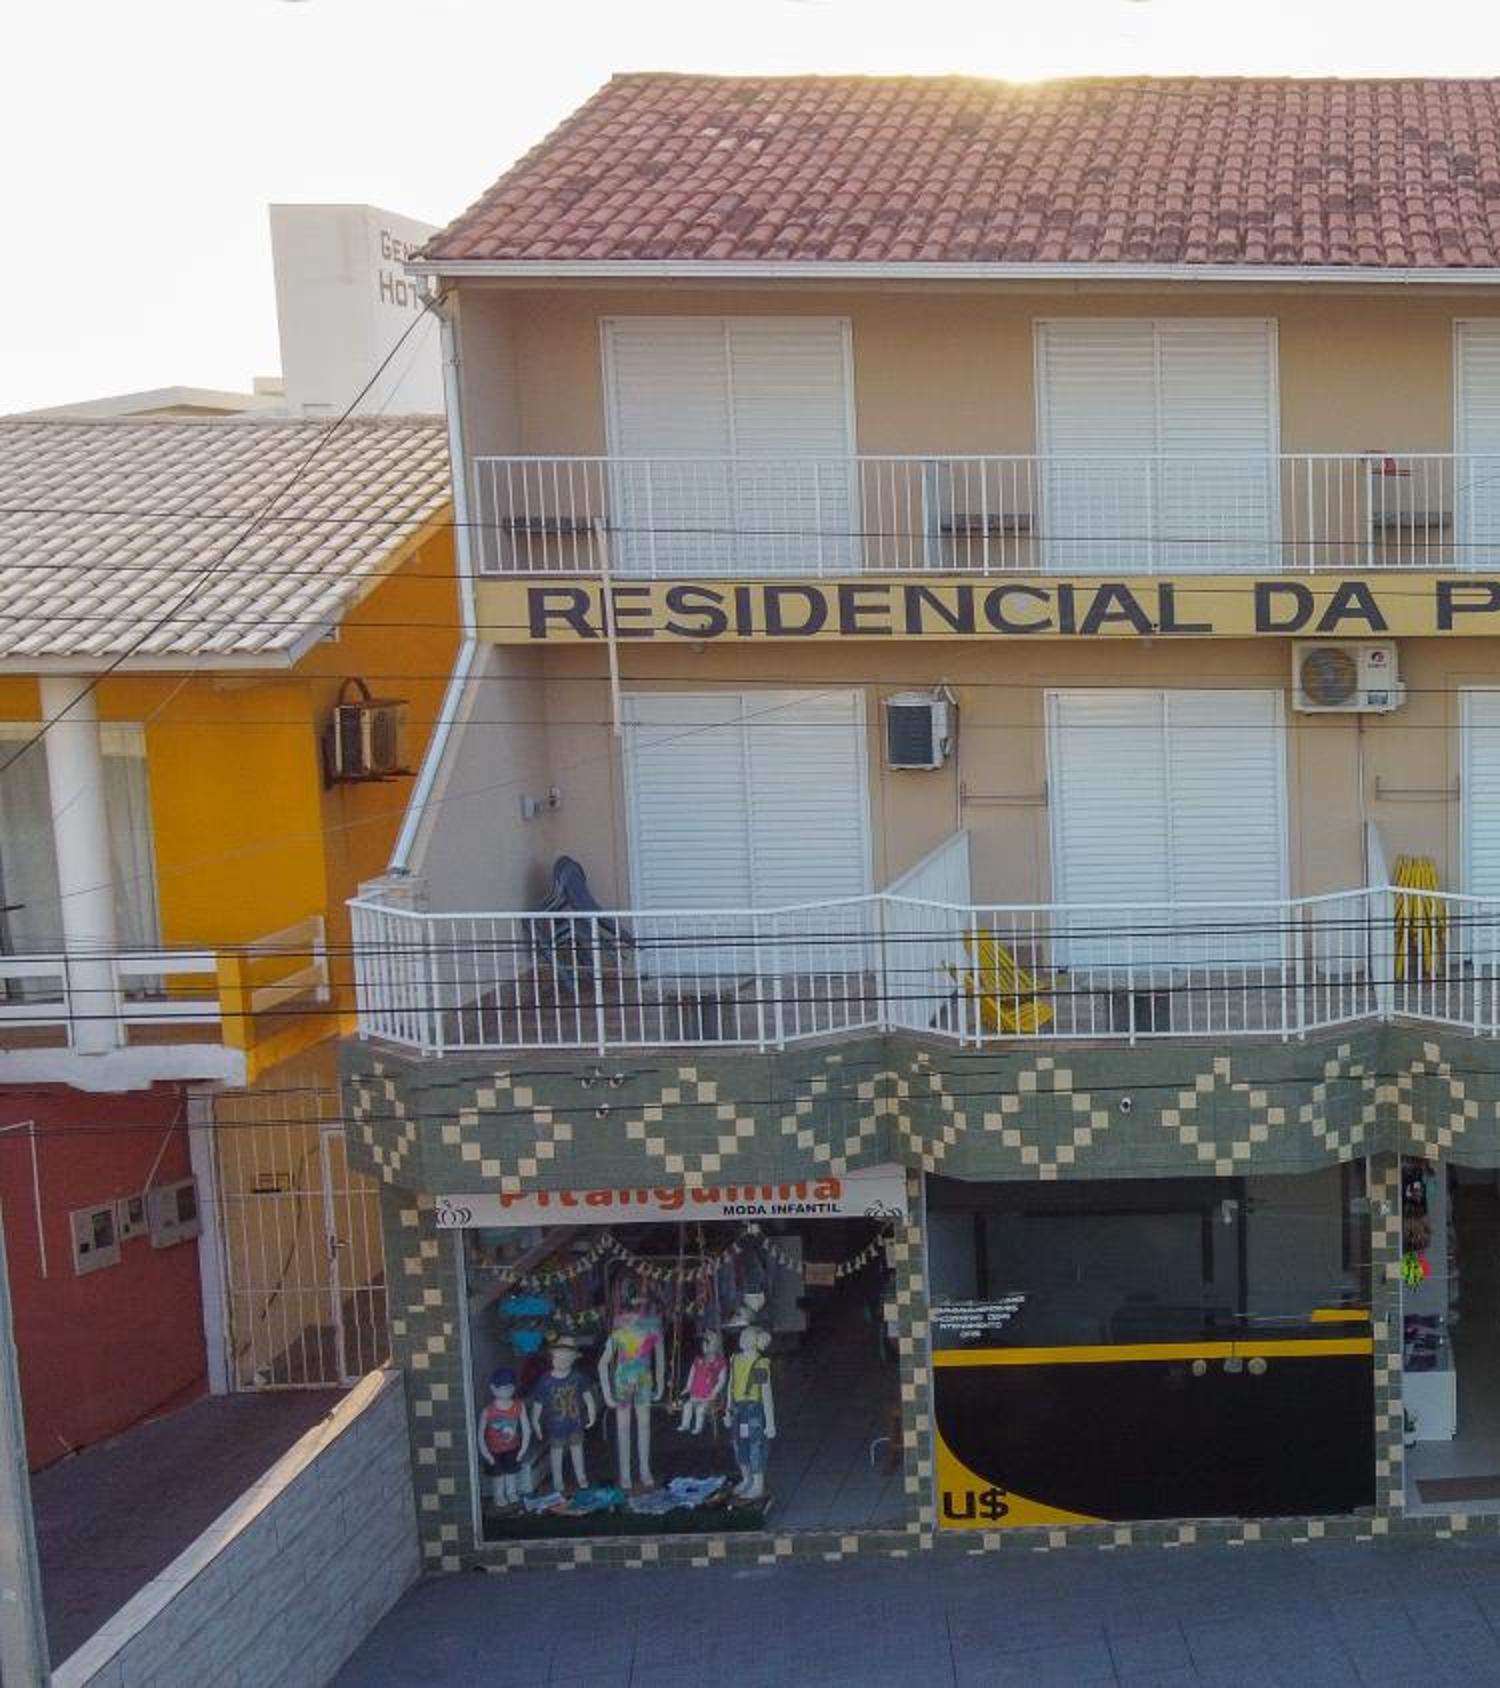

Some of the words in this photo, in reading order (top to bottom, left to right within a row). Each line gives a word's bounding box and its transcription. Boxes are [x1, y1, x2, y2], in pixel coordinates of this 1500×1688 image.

[527, 584, 1212, 639] RESIDENCIAL
[1254, 582, 1389, 632] DA
[723, 1205, 766, 1216] MODA
[771, 1203, 841, 1215] INFANTIL
[943, 1487, 1009, 1521] U$
